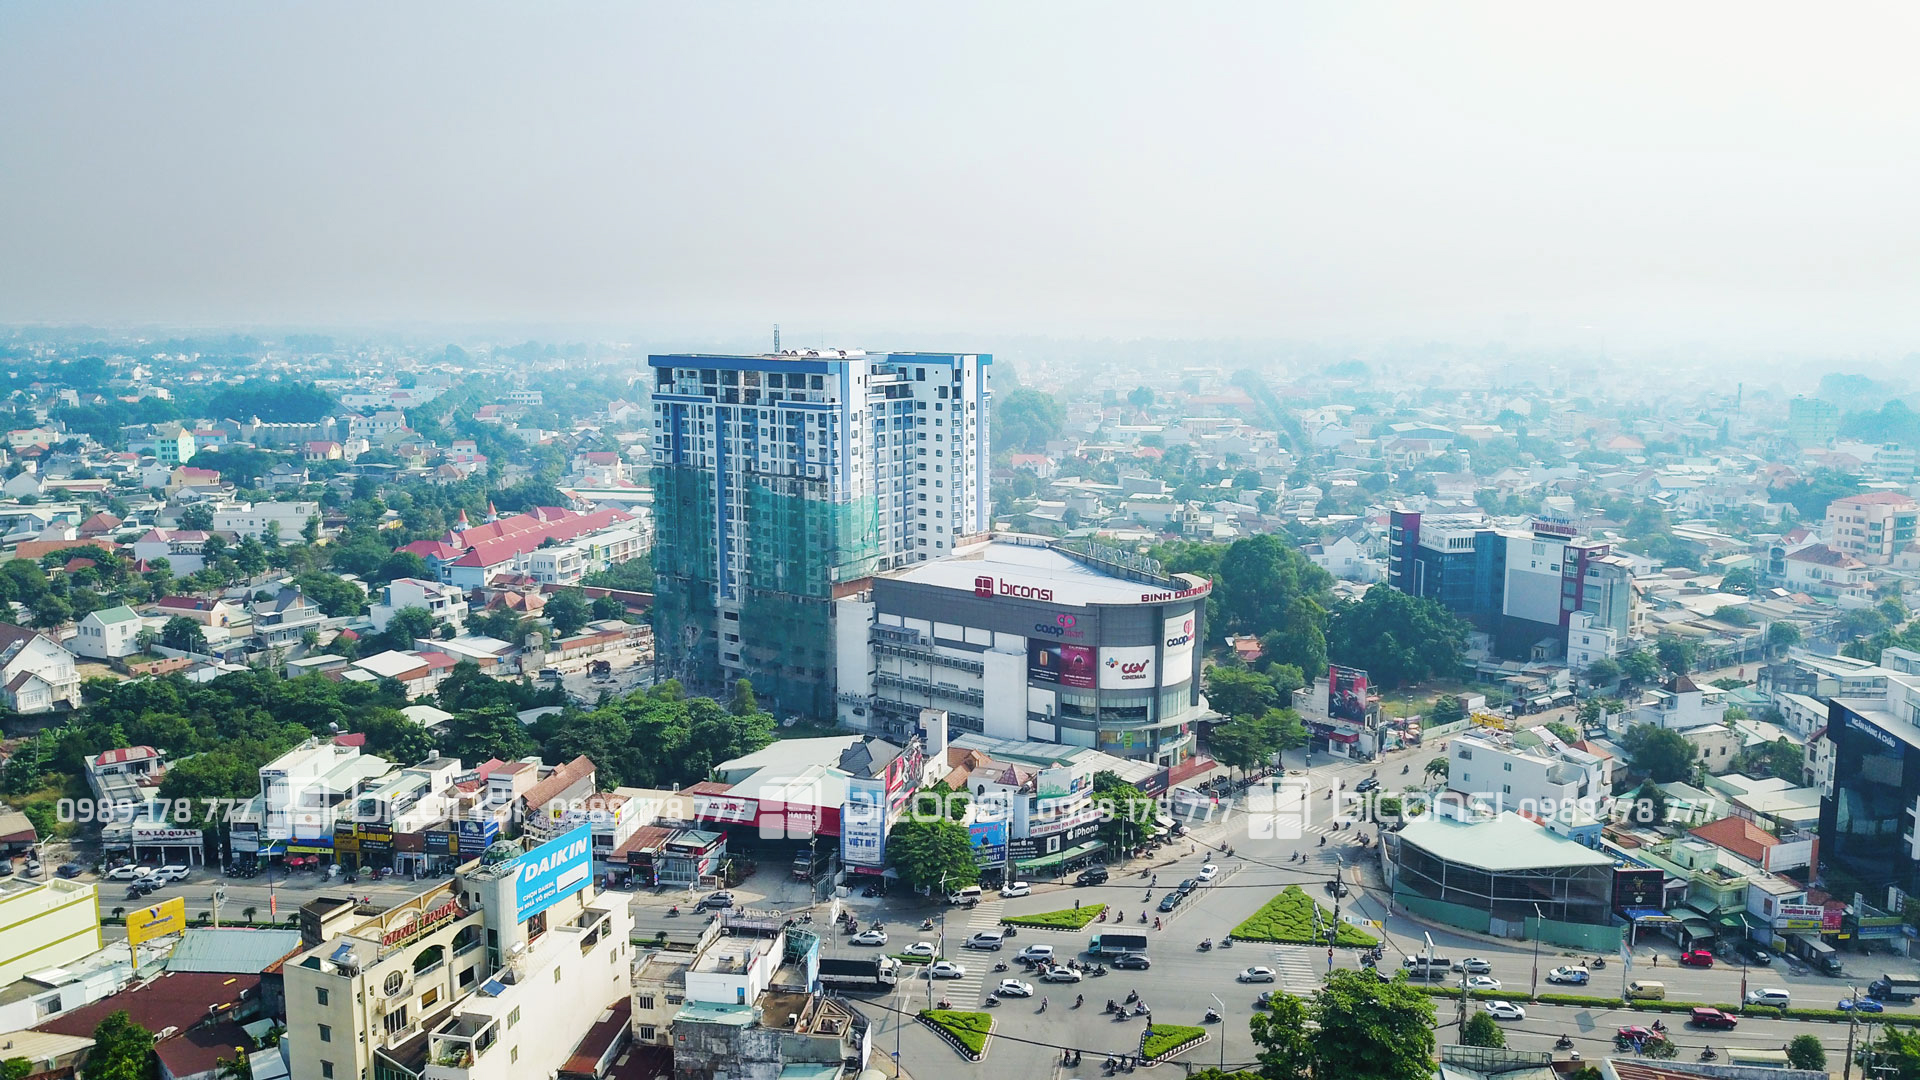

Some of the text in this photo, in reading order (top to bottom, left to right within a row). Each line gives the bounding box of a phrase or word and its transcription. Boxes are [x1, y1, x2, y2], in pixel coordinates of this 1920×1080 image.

[1000, 578, 1053, 601] biconsi
[1122, 660, 1148, 675] CGV
[1074, 824, 1099, 838] iPhone
[524, 836, 588, 883] DAIKIN
